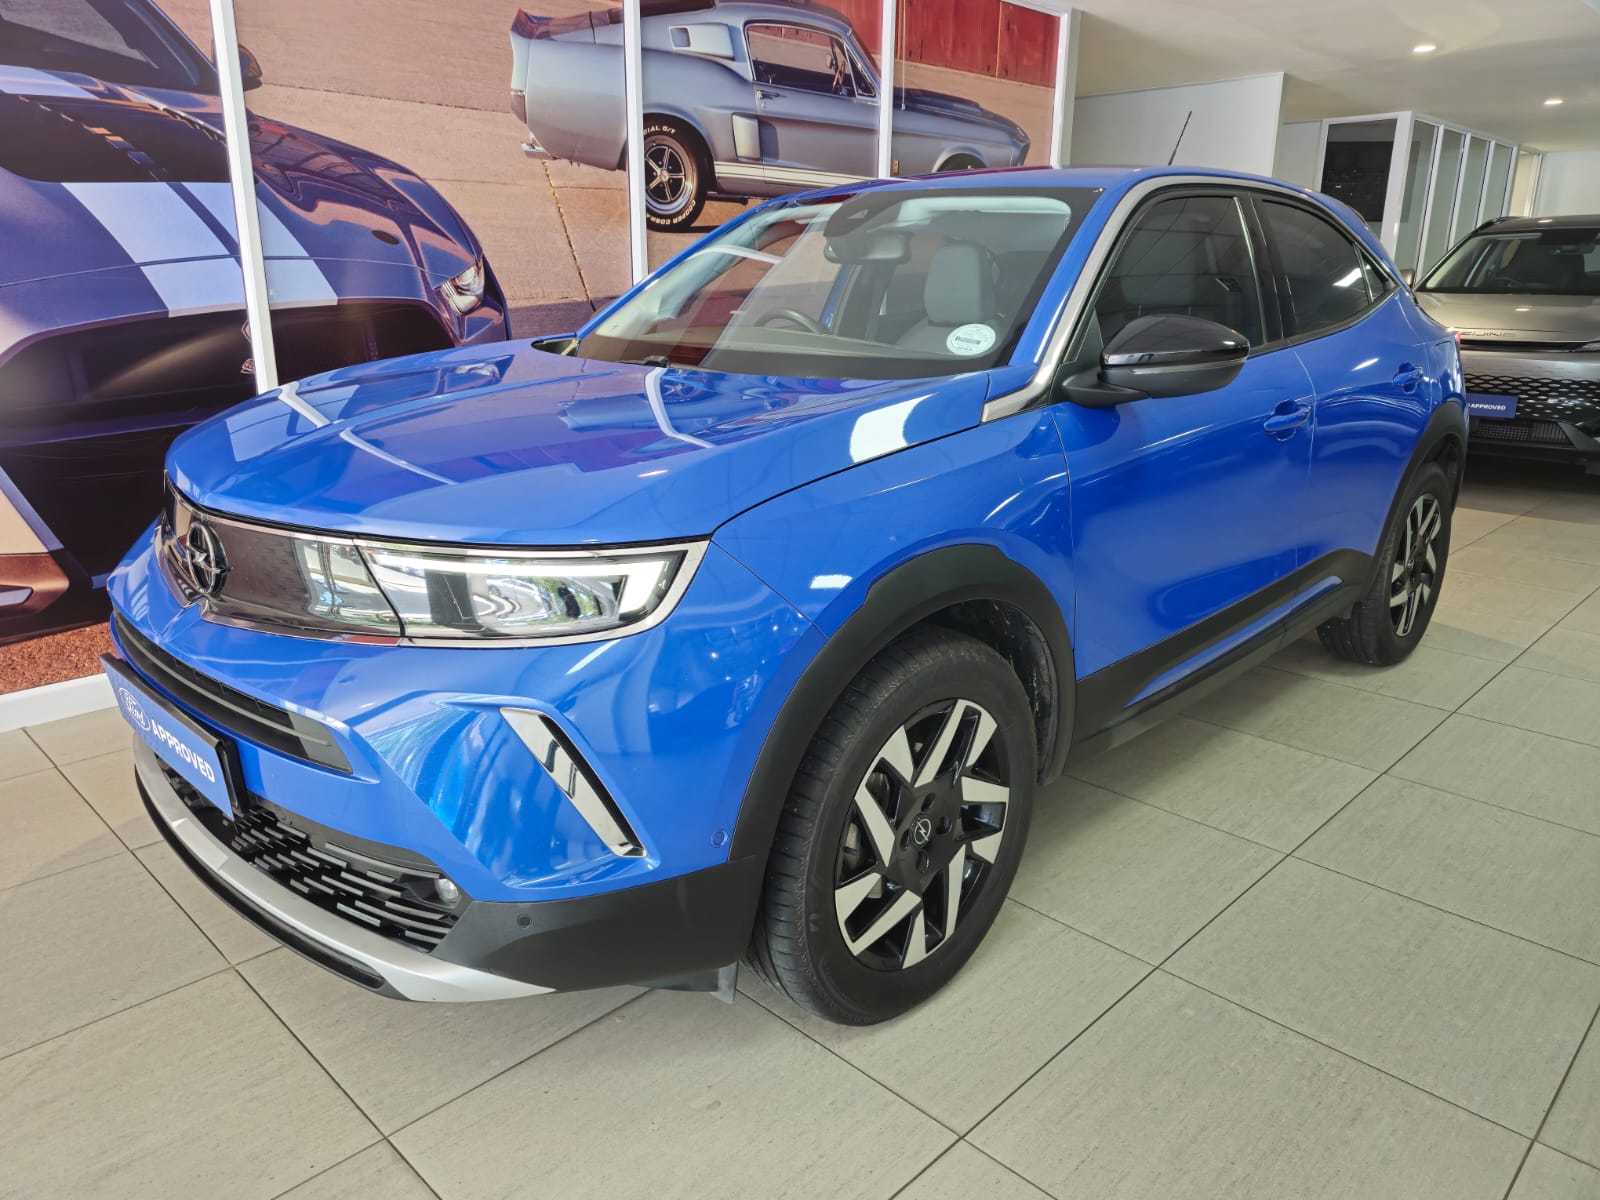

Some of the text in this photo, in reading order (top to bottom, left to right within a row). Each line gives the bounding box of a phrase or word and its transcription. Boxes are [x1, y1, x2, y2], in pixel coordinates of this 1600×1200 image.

[672, 199, 696, 224] COOPER
[1470, 403, 1507, 411] APPROVED
[124, 691, 216, 784] Ford APPROVED
